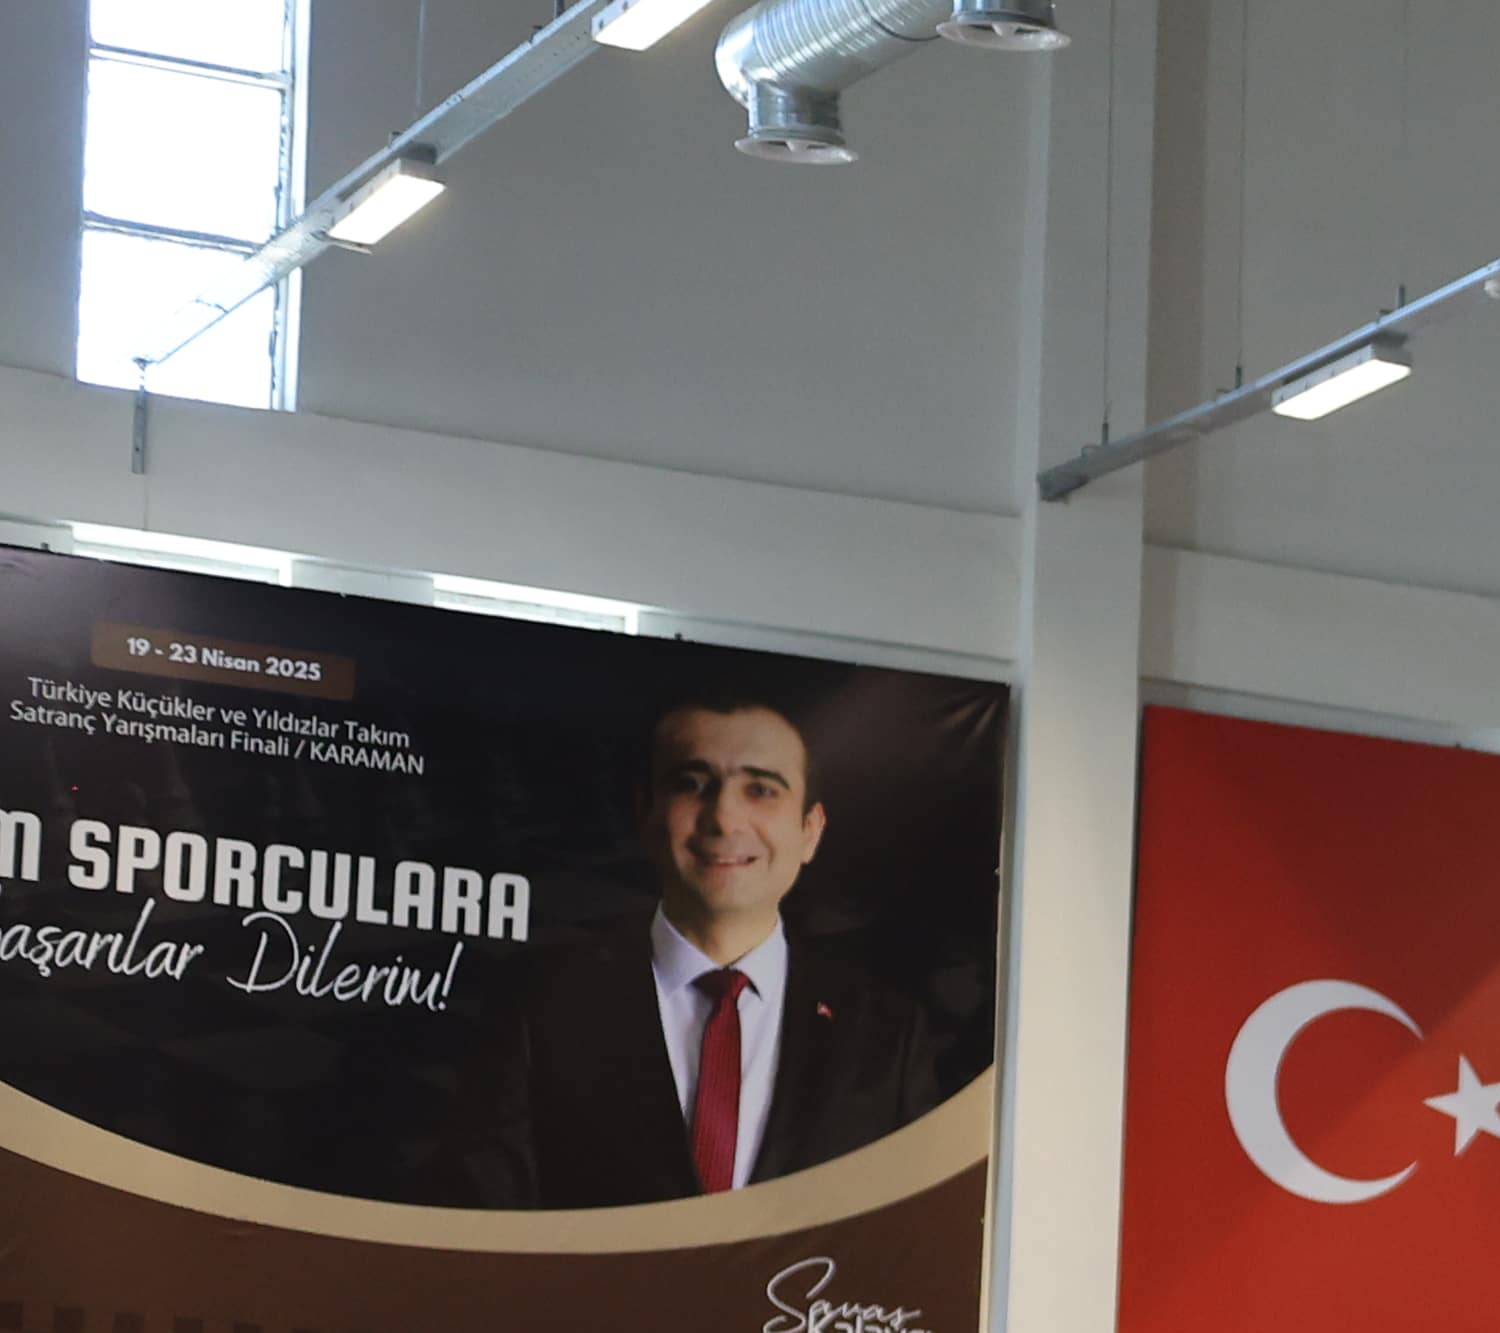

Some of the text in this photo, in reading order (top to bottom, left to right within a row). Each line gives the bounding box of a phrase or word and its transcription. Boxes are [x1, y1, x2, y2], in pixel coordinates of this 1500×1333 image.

[127, 638, 151, 656] 19
[169, 644, 197, 664] 23
[202, 648, 260, 673] Nisan
[266, 657, 321, 680] 2025
[9, 701, 96, 734] Satranç
[102, 714, 224, 748] Yarışmaları
[231, 731, 289, 757] Finali
[310, 742, 424, 774] KARAMAN
[27, 676, 409, 748] Türkiye Küçükler ve Yıldızlar Takım
[67, 818, 531, 941] SPORCULARA
[0, 897, 464, 1011] aşarılar Dilerim!
